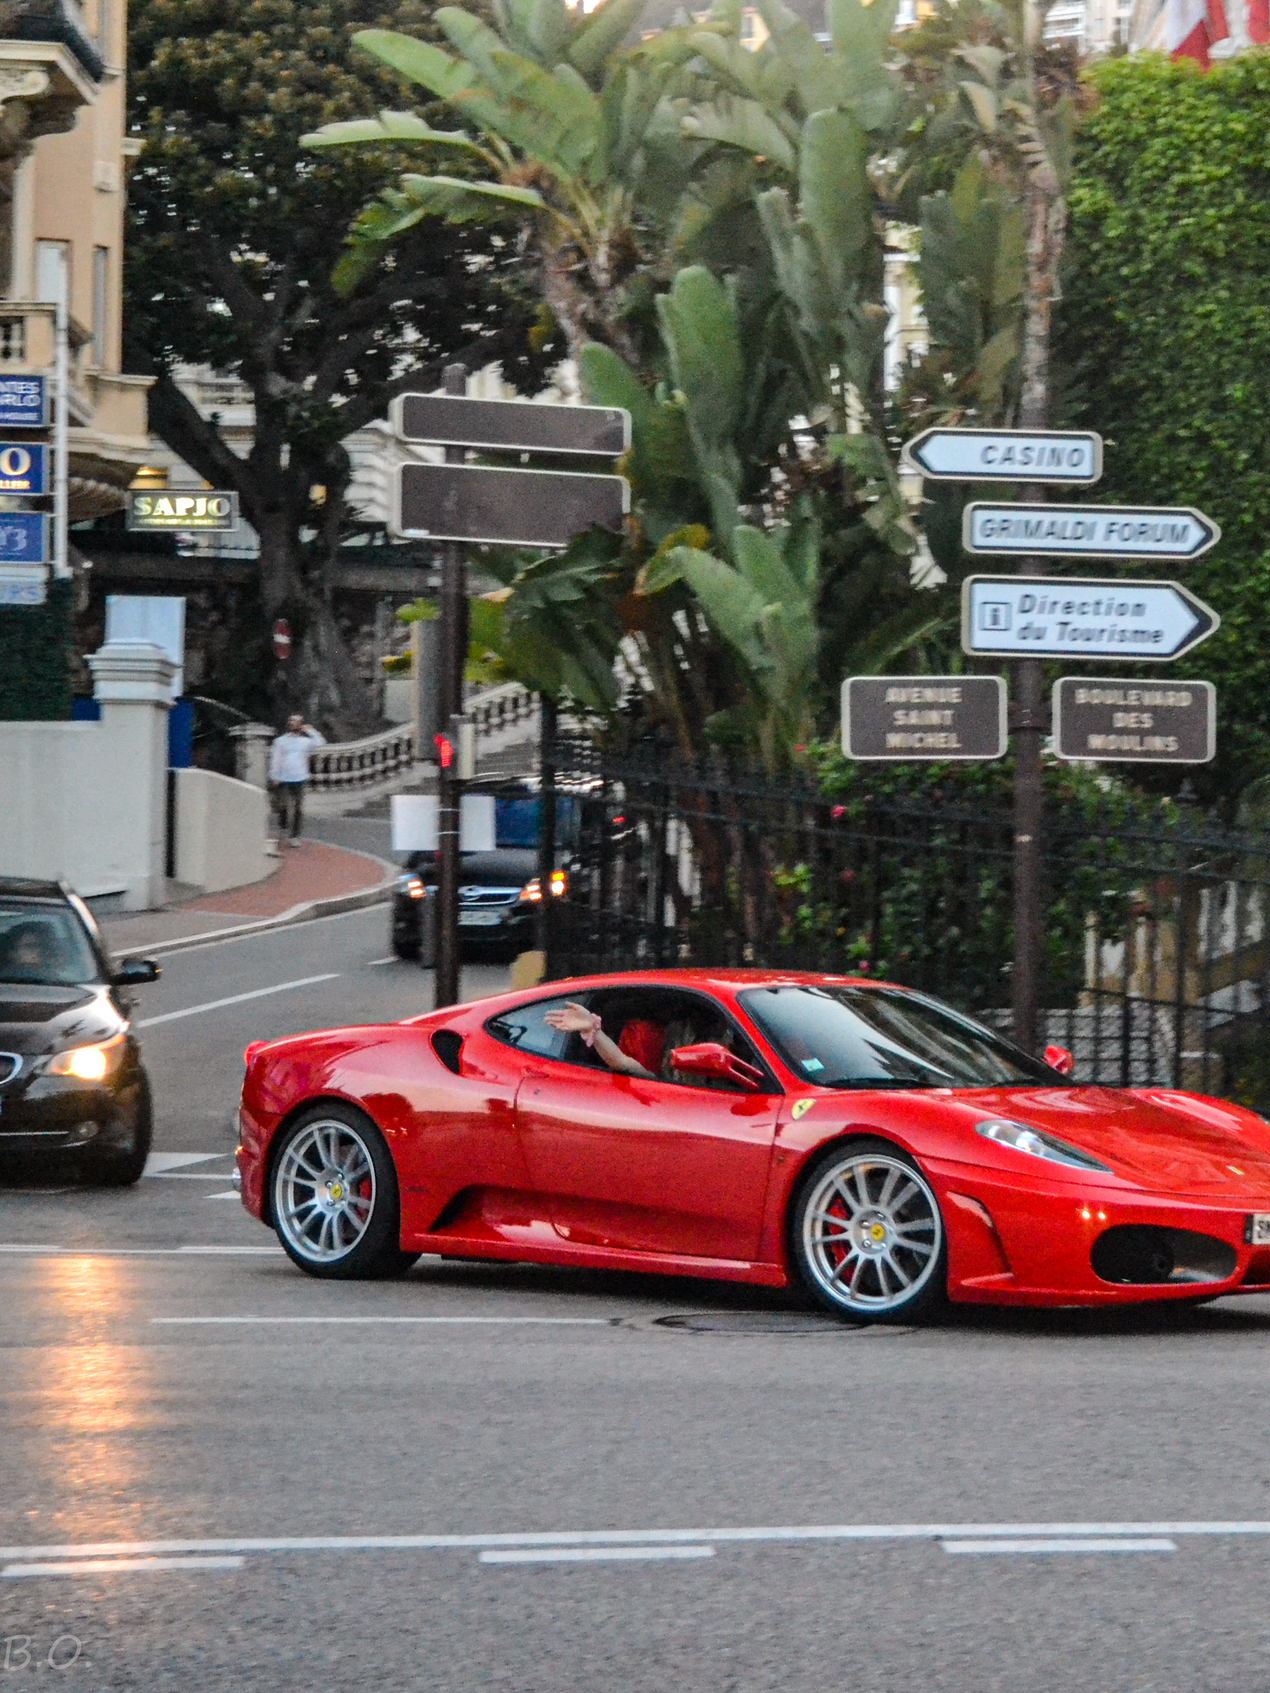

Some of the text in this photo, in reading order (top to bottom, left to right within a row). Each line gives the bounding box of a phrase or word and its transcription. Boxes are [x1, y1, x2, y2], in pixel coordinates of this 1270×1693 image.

[0, 447, 31, 476] O
[980, 445, 1085, 467] CASINO
[134, 497, 231, 517] SAPJO
[979, 518, 1191, 544] GRIMALDI FORUM
[1017, 594, 1148, 617] Direction
[1016, 621, 1165, 644] du Tourisme
[885, 687, 962, 703] AVENUE
[1075, 688, 1193, 707] BOULEVARD
[893, 709, 955, 725] SAINT
[1113, 712, 1154, 728] DES
[885, 732, 962, 748] MICHEL
[1087, 734, 1179, 751] MOULINS
